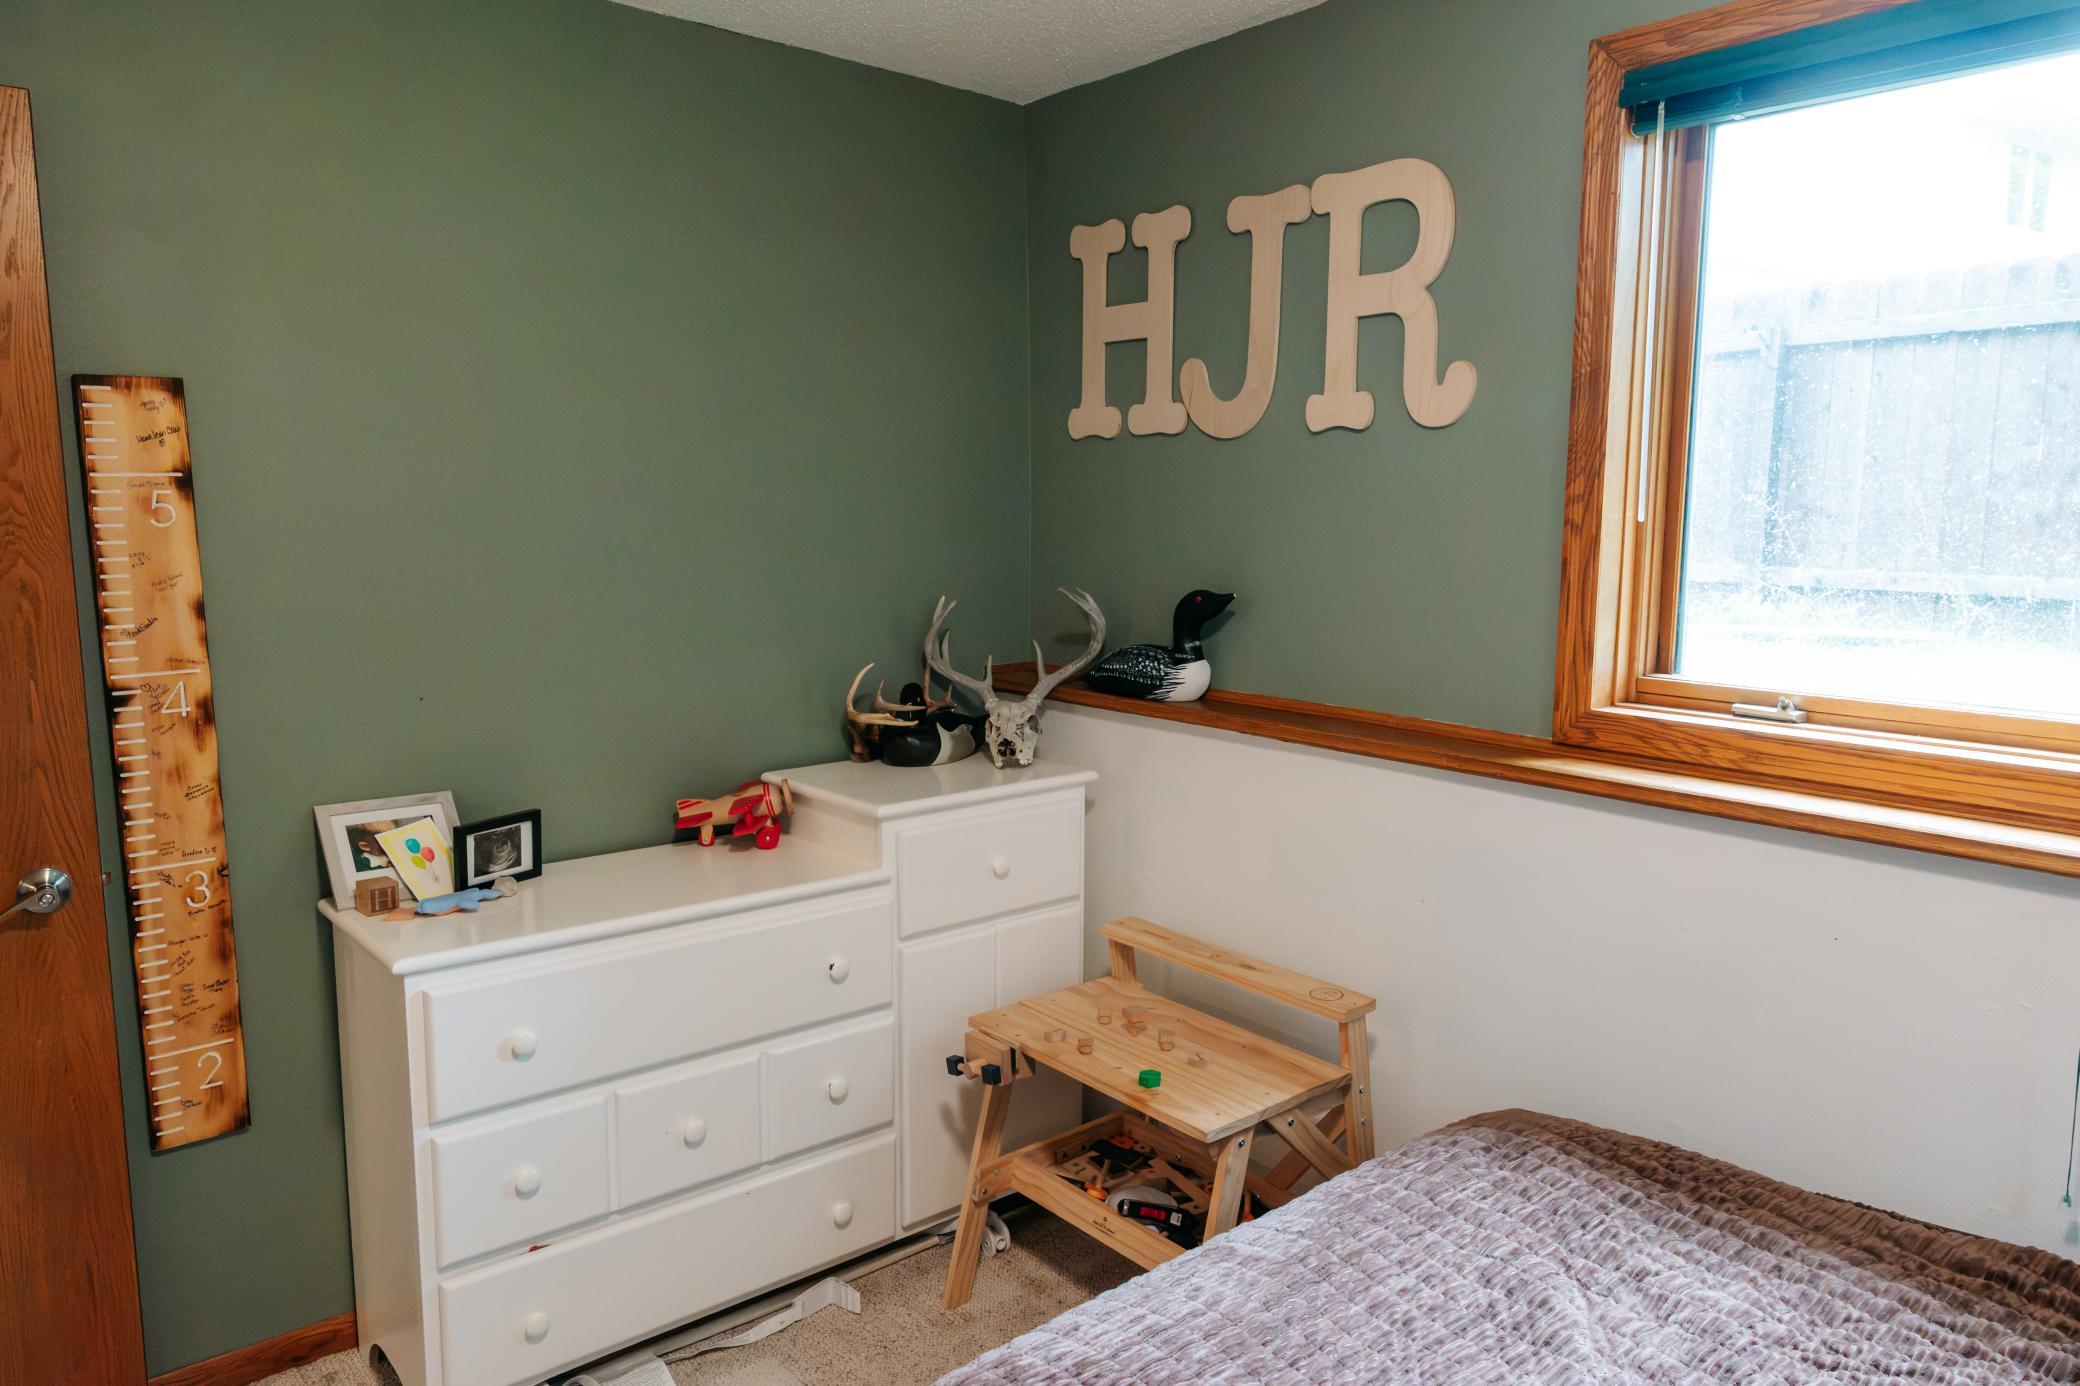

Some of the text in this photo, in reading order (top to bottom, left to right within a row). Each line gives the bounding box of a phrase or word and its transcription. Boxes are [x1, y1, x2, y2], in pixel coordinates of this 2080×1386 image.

[150, 489, 176, 528] 5
[161, 681, 192, 717] 4
[186, 870, 211, 907] 3
[374, 887, 395, 912] H
[197, 1051, 224, 1089] 2
